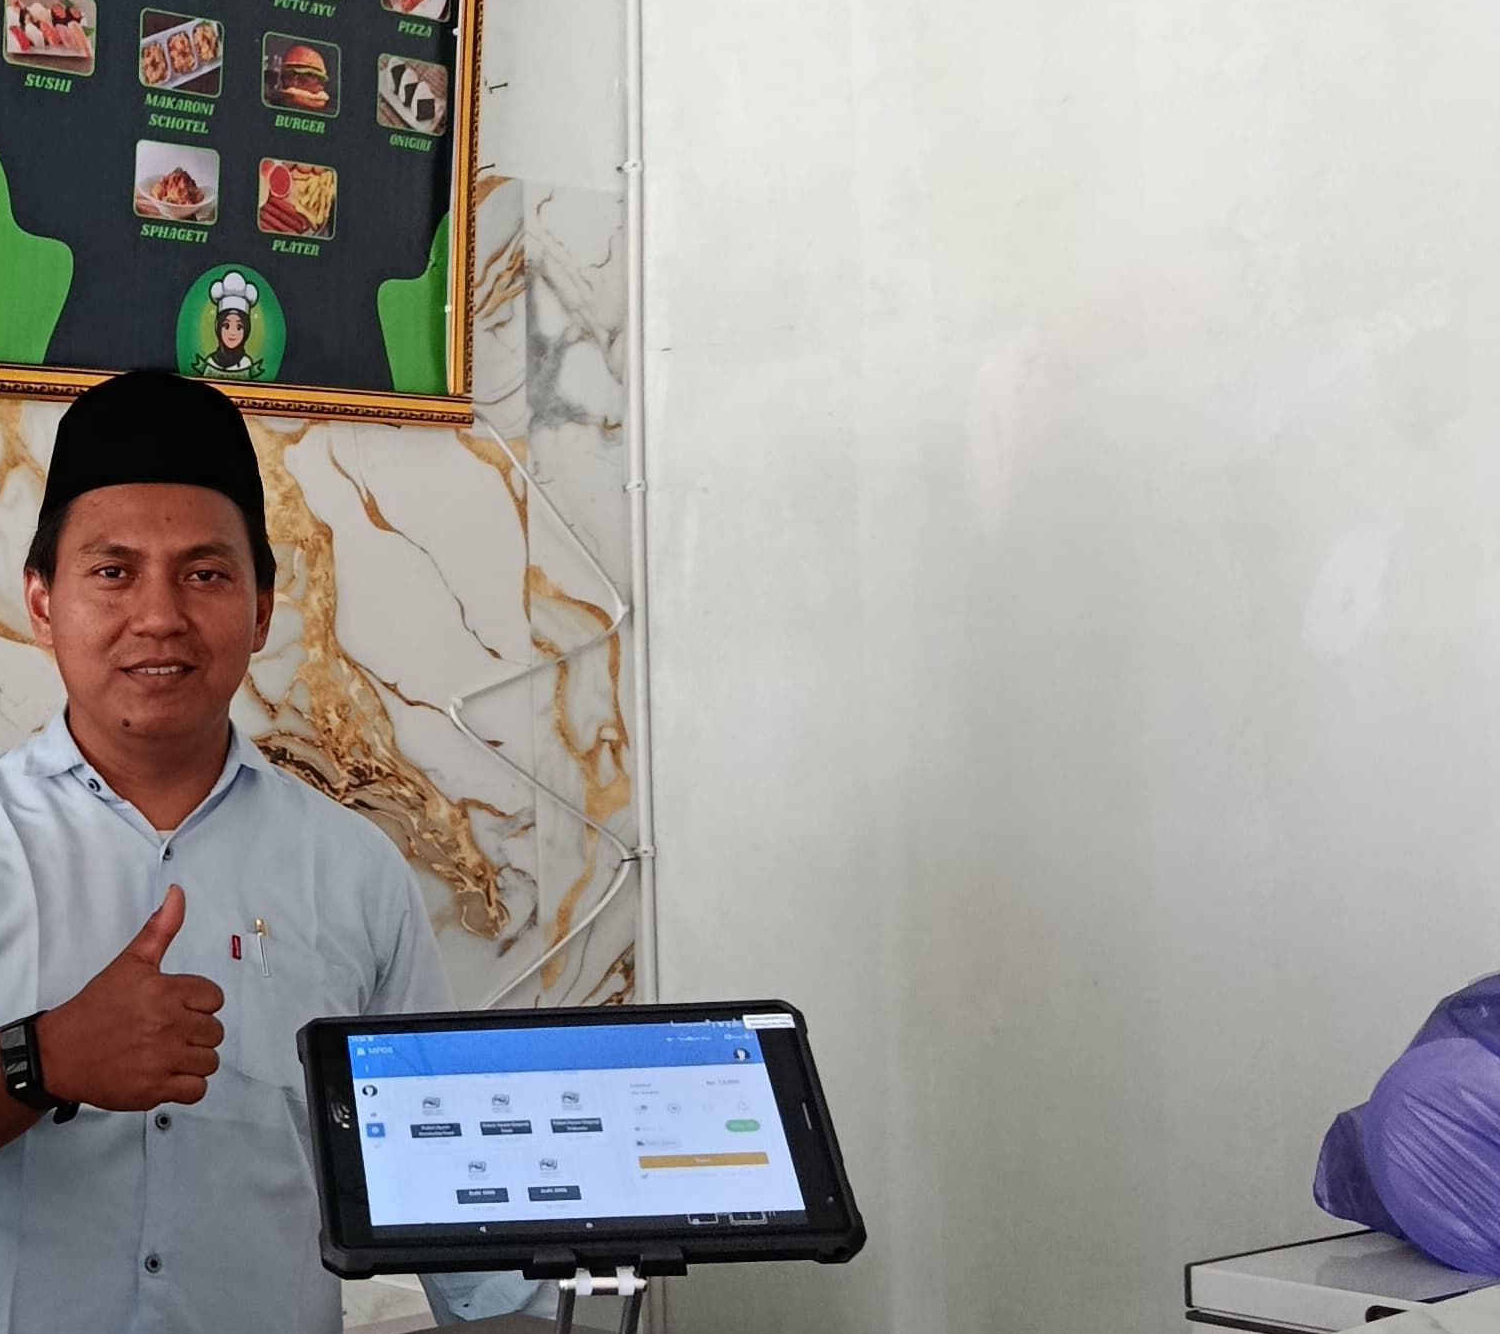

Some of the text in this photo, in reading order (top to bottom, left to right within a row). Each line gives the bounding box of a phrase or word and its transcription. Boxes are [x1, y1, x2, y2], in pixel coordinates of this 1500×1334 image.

[310, 3, 335, 17] AYU
[398, 21, 432, 37] PIZZA
[25, 74, 72, 92] SUSHI
[145, 93, 214, 115] MAKARONI
[148, 114, 208, 133] SCHOTEL
[275, 115, 325, 133] BURGER
[390, 134, 432, 151] ONIGIRI
[141, 224, 208, 243] SPHAGETI
[272, 240, 319, 256] PLATER
